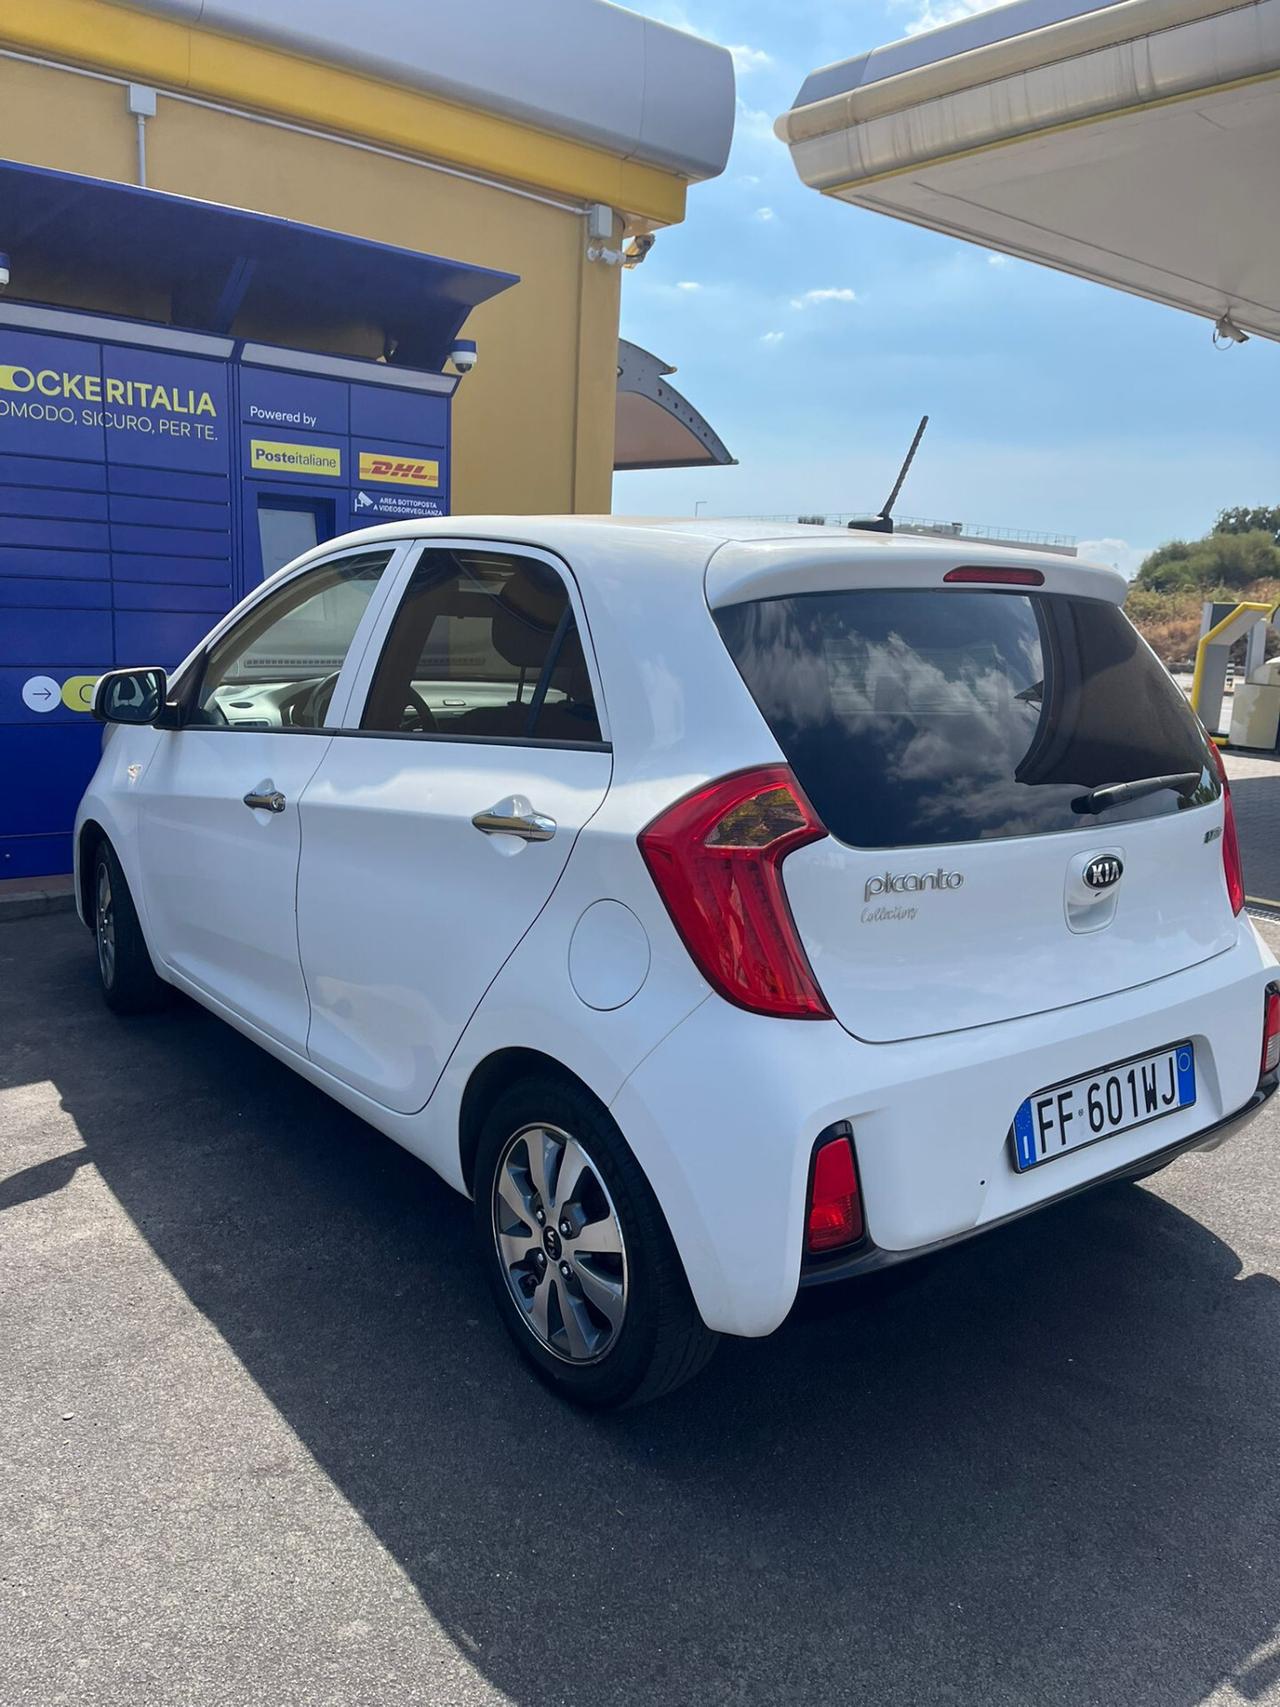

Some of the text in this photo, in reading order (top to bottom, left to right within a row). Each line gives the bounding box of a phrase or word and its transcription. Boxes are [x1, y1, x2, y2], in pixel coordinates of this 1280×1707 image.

[82, 409, 156, 434] SICURO,
[159, 419, 191, 437] PER
[194, 424, 219, 441] TE.
[250, 405, 317, 427] Powered by
[255, 448, 337, 469] Posteitaliane
[370, 460, 429, 481] DHL
[380, 497, 397, 505] AREA
[1091, 861, 1120, 884] KIA
[864, 868, 964, 902] picanto
[1037, 1057, 1176, 1154] FF 601WJ
